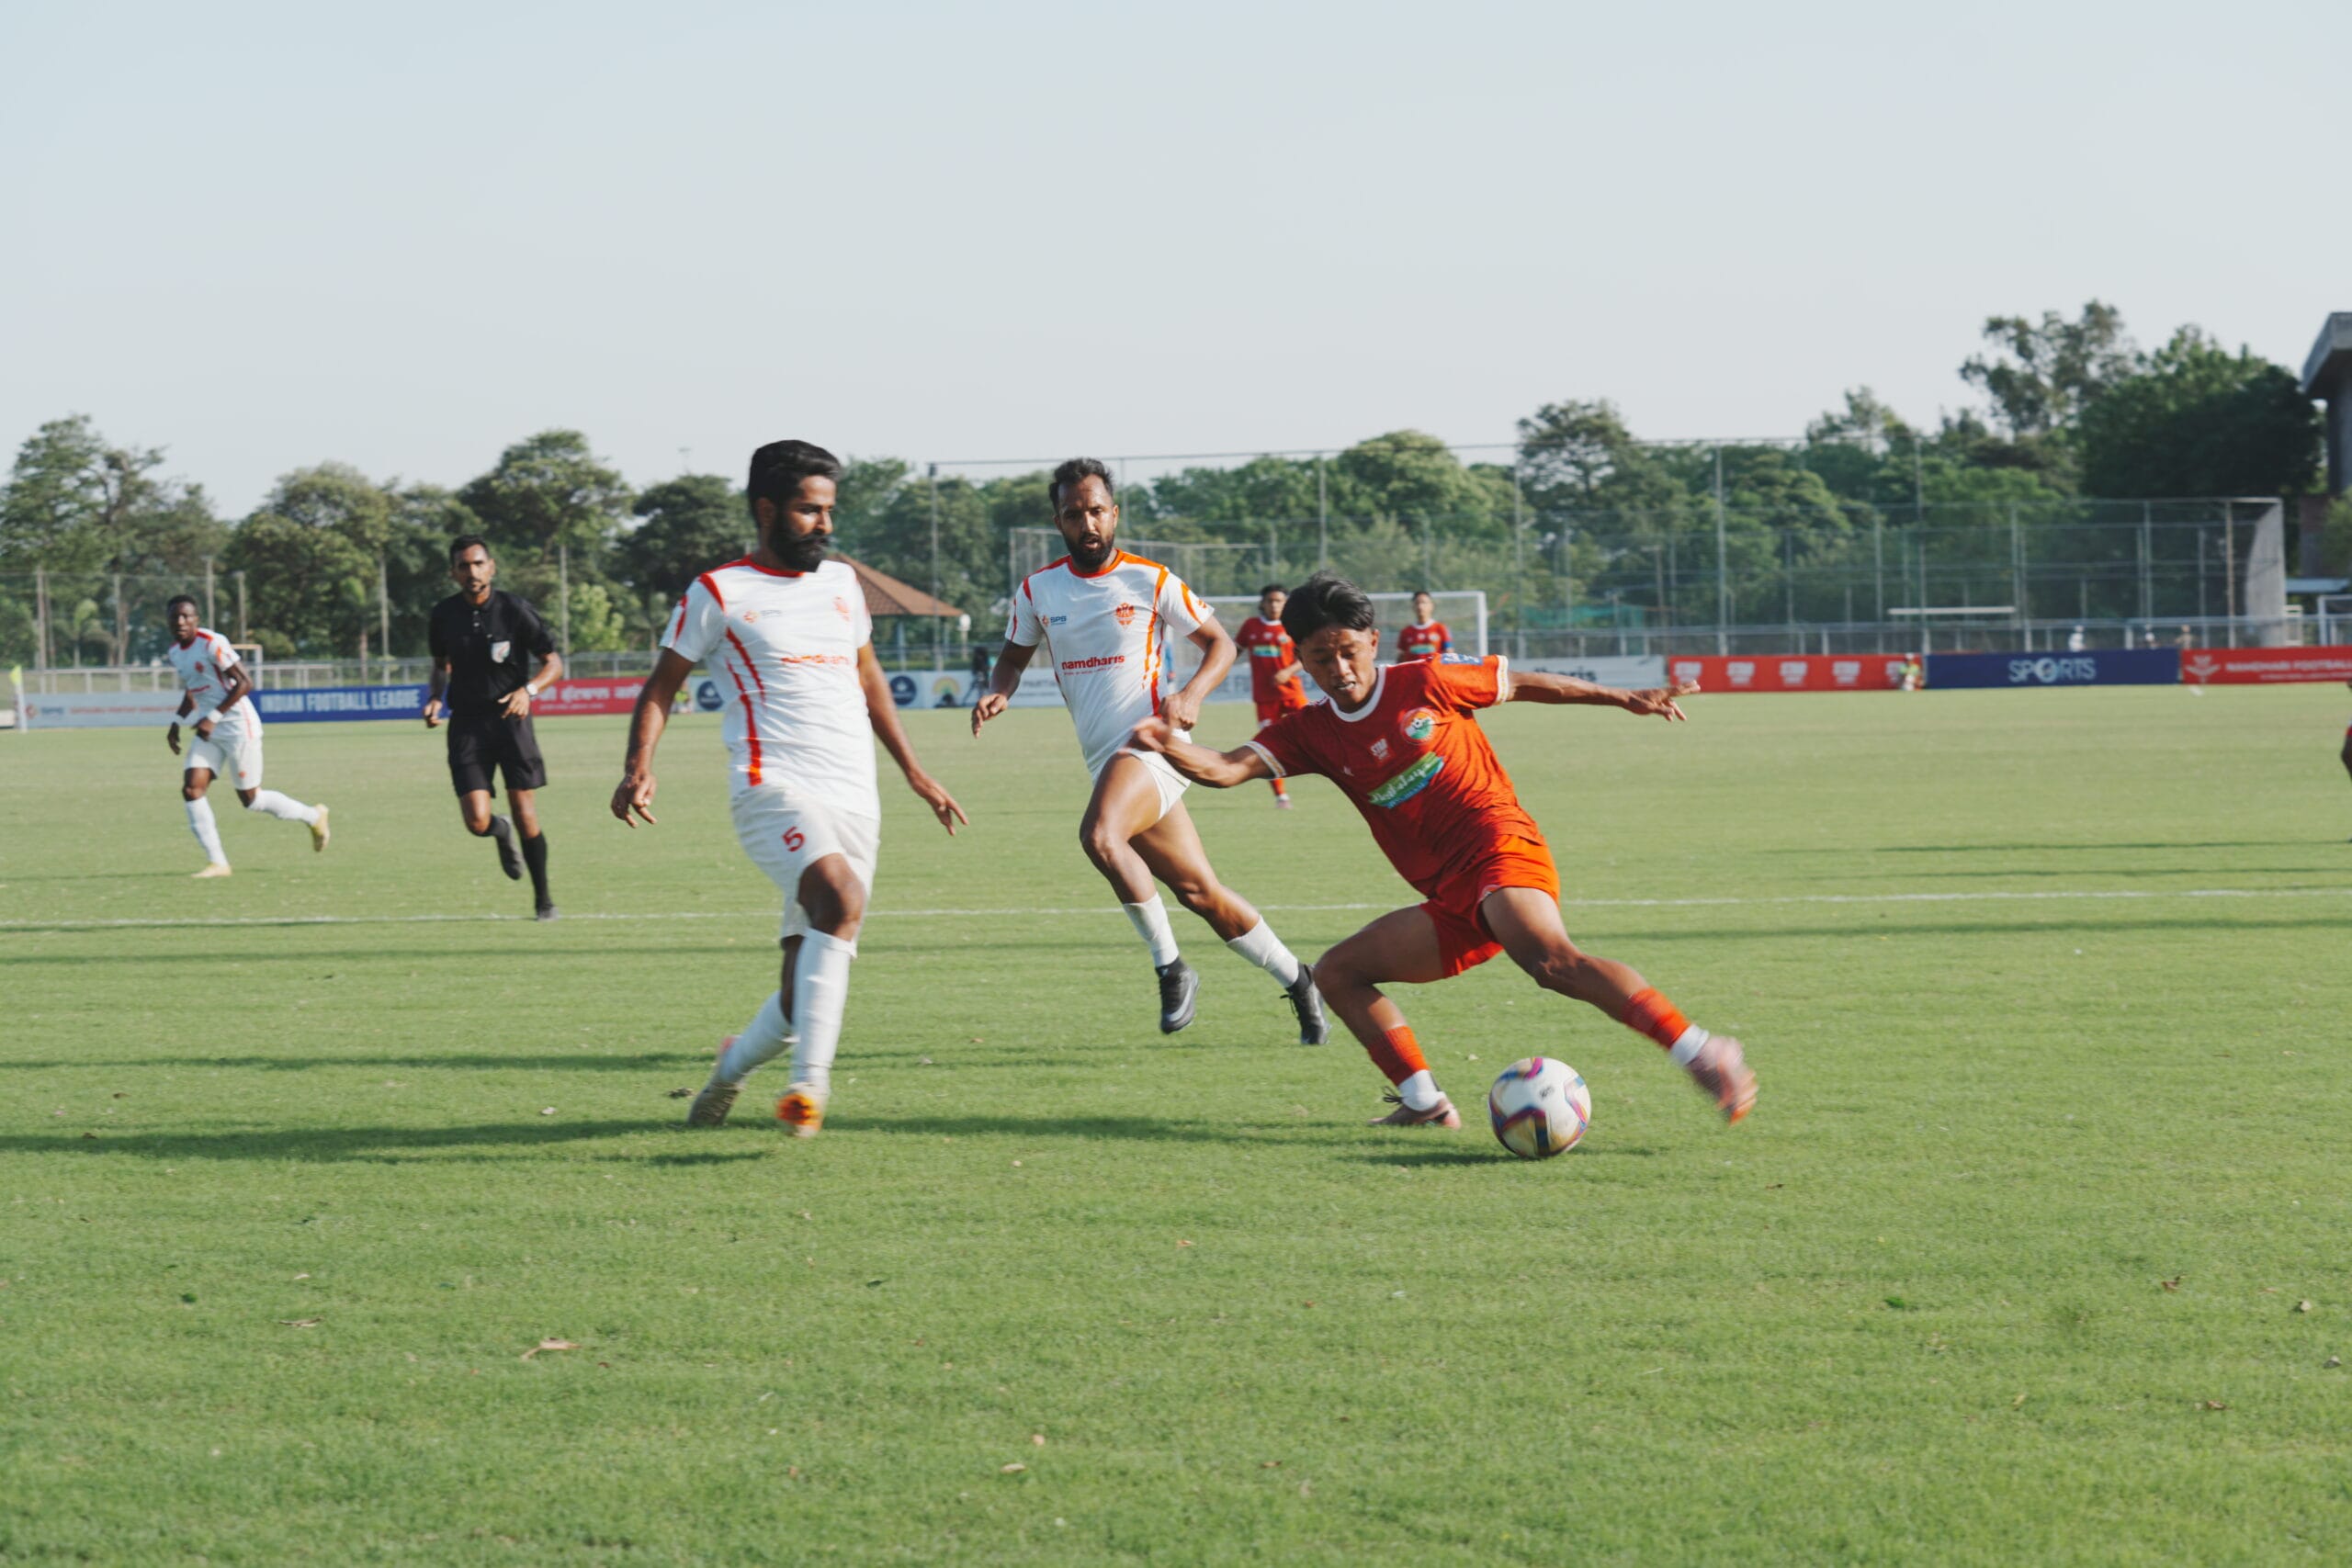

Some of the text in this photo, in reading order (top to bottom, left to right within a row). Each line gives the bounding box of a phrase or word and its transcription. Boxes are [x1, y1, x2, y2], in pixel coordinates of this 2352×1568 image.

[1062, 654, 1125, 671] namdharis
[2008, 658, 2096, 682] SPORTS
[260, 688, 421, 713] INDIAN FOOTBALL LEAGUE
[783, 826, 805, 852] 5
